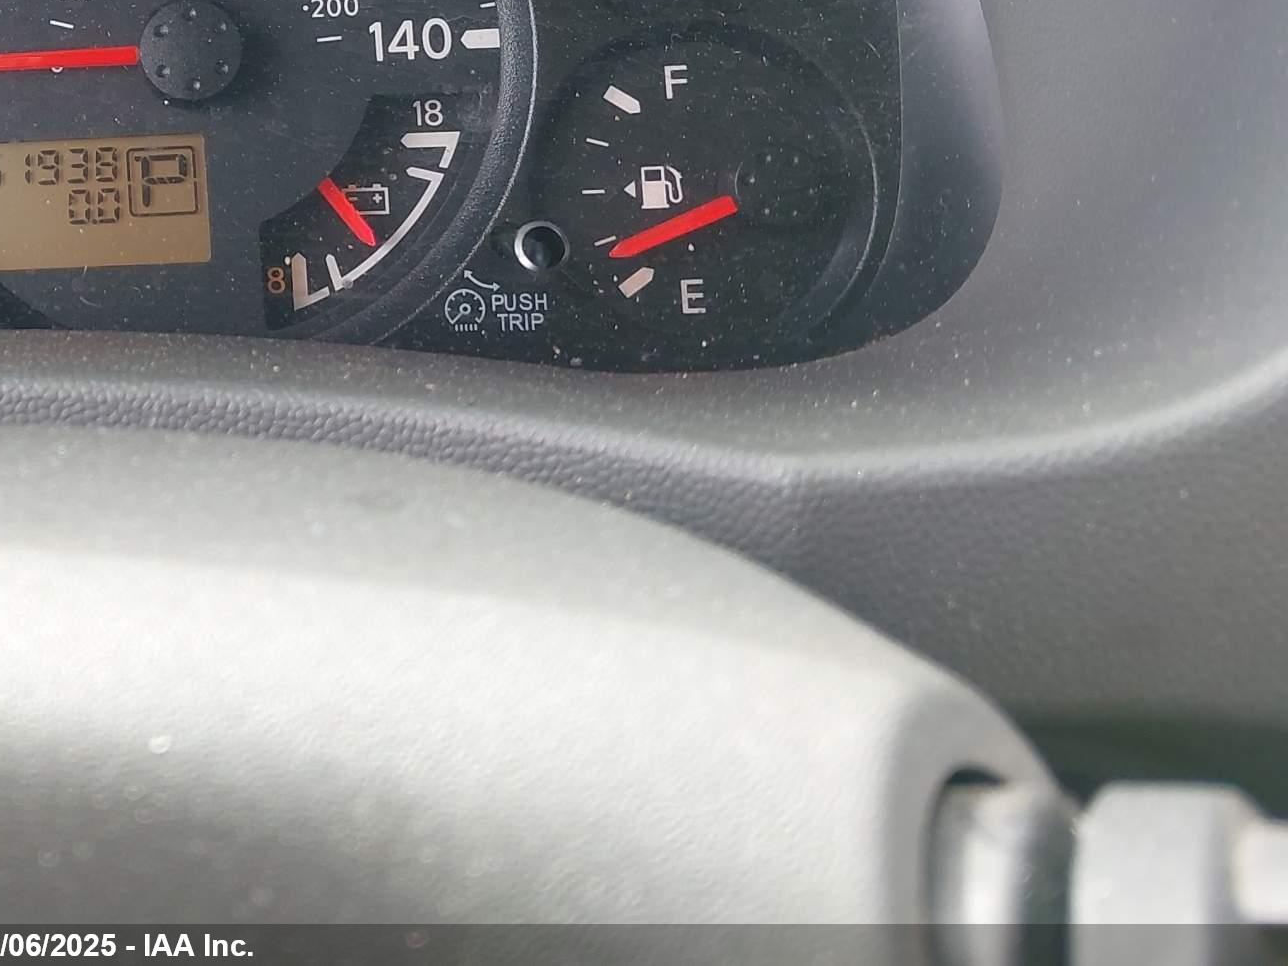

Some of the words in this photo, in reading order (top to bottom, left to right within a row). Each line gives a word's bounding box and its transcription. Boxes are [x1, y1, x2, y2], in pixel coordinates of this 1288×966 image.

[368, 17, 452, 62] 140
[664, 65, 688, 99] F
[412, 100, 443, 126] 18
[138, 153, 187, 207] P
[267, 266, 285, 294] 8
[491, 294, 548, 312] PUSH
[680, 279, 706, 314] E
[497, 314, 545, 331] TRIP
